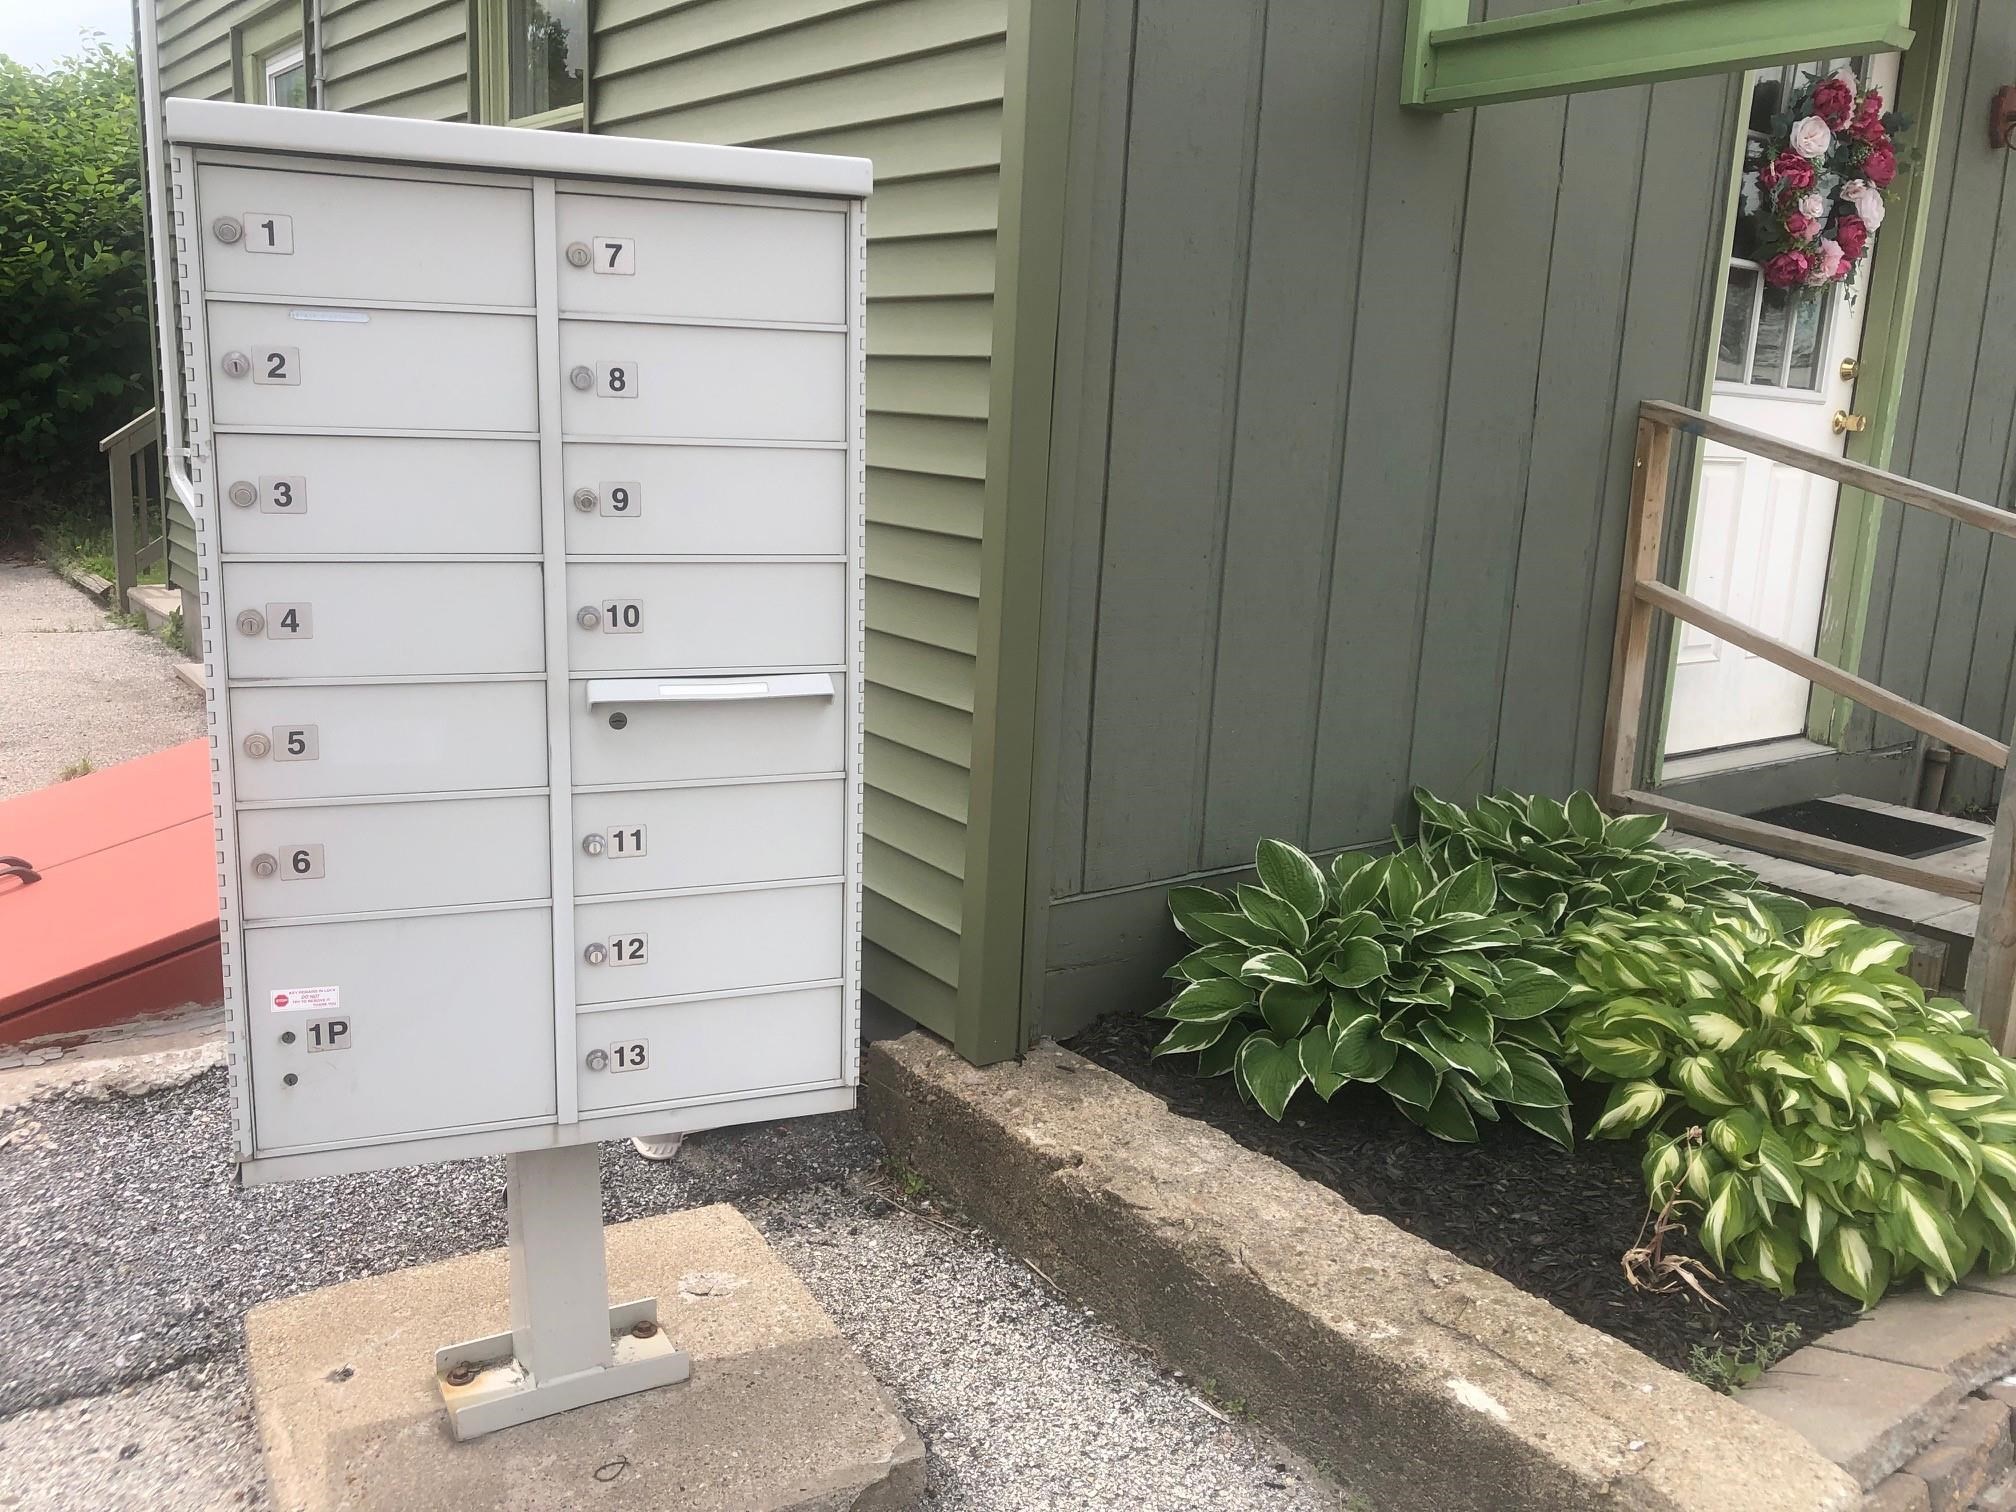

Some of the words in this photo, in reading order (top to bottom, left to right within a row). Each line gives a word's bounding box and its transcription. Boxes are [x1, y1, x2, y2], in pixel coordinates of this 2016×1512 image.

[261, 219, 275, 247] 1
[605, 243, 623, 268] 7
[267, 352, 287, 379] 2
[609, 367, 626, 392] 8
[273, 481, 293, 508] 3
[611, 487, 629, 512] 9
[280, 608, 300, 633] 4
[606, 604, 640, 628] 10
[287, 730, 306, 755] 5
[613, 829, 641, 852] 11
[292, 850, 311, 874] 6
[612, 938, 644, 961] 12
[308, 1021, 347, 1046] 1P
[614, 1044, 646, 1067] 13
